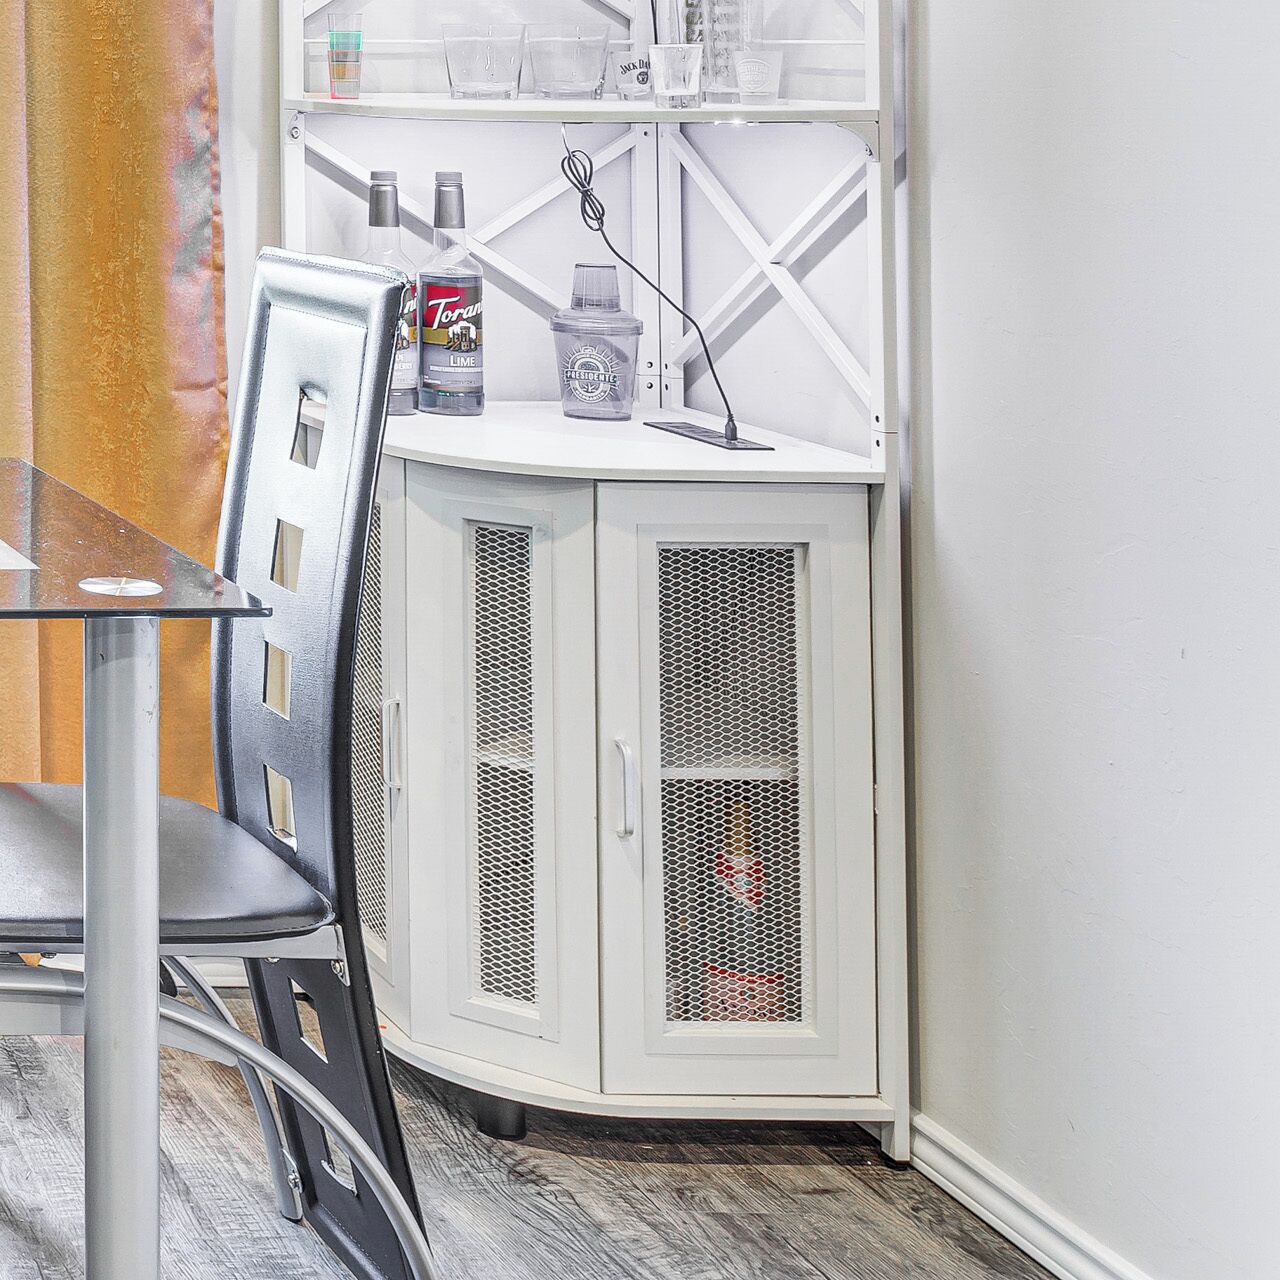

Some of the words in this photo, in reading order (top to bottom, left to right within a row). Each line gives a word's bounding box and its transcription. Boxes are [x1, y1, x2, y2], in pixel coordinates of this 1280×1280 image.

[619, 62, 638, 75] JACK
[428, 295, 483, 331] Toran
[566, 370, 616, 384] PRESIDENTE
